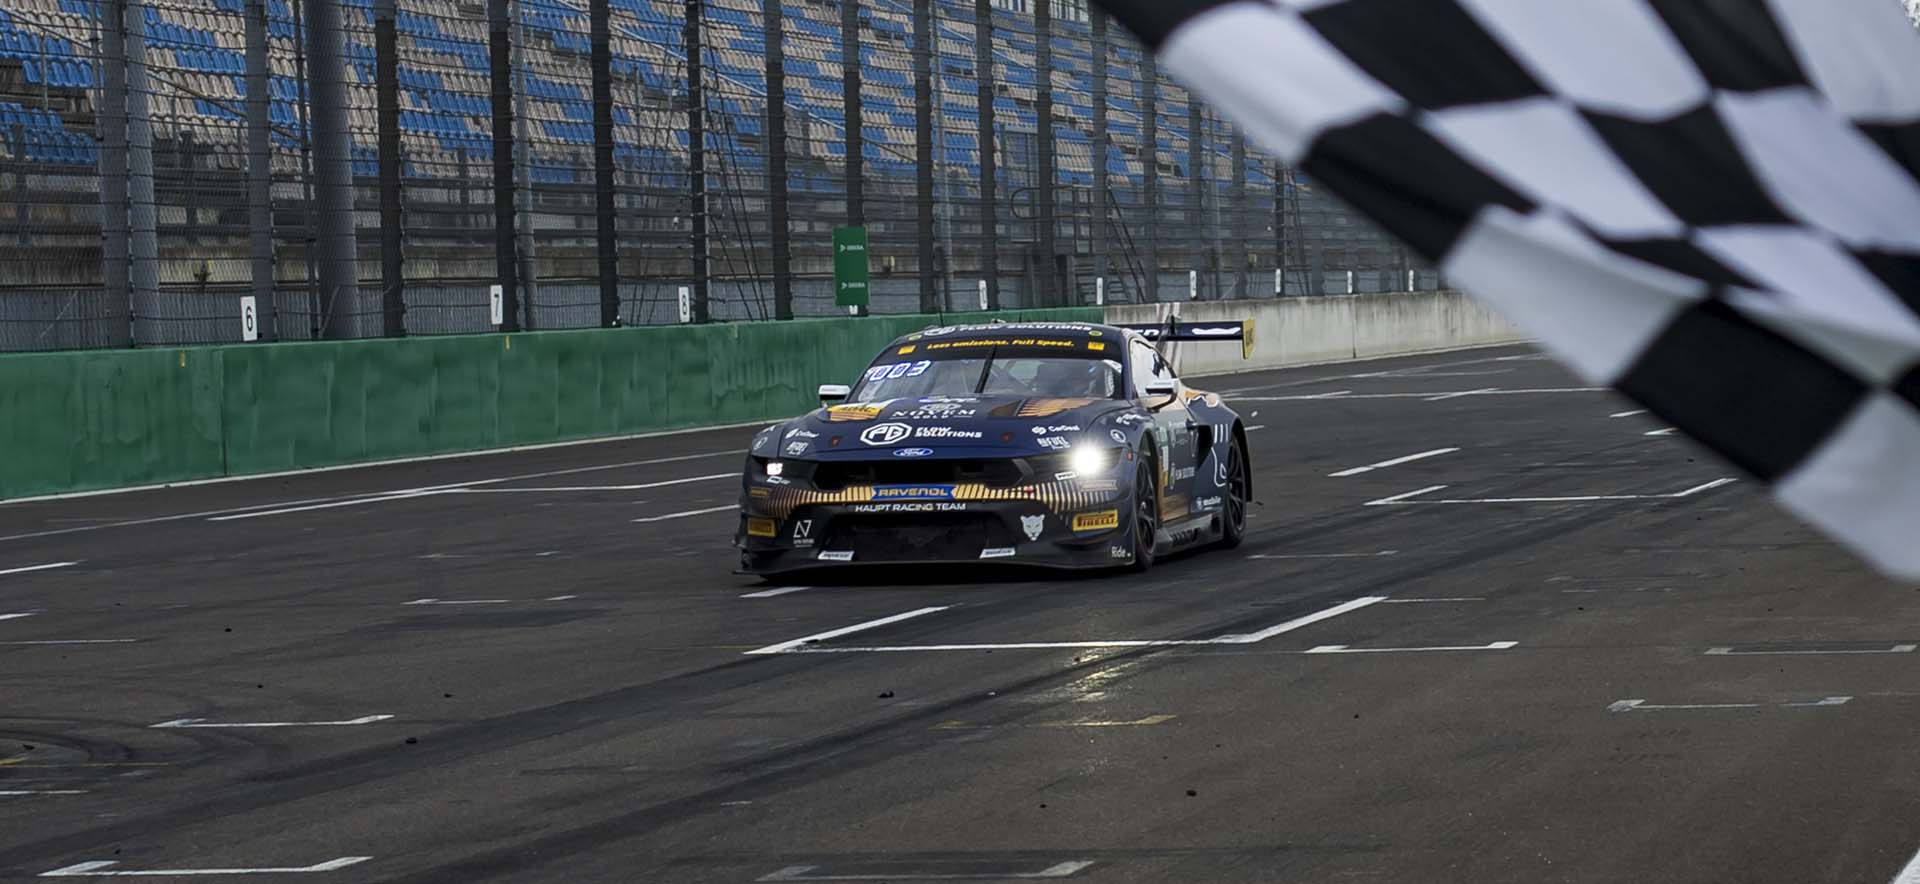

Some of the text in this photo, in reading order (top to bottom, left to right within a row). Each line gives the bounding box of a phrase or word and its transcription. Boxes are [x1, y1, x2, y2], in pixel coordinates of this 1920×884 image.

[494, 293, 499, 317] 7
[681, 294, 688, 315] 8
[246, 305, 253, 331] 6
[915, 431, 982, 439] SOLUTIONS
[878, 487, 948, 497] RAVENOL
[855, 502, 966, 512] HAUPT RACING TEAM
[1077, 513, 1115, 527] PIRELLI
